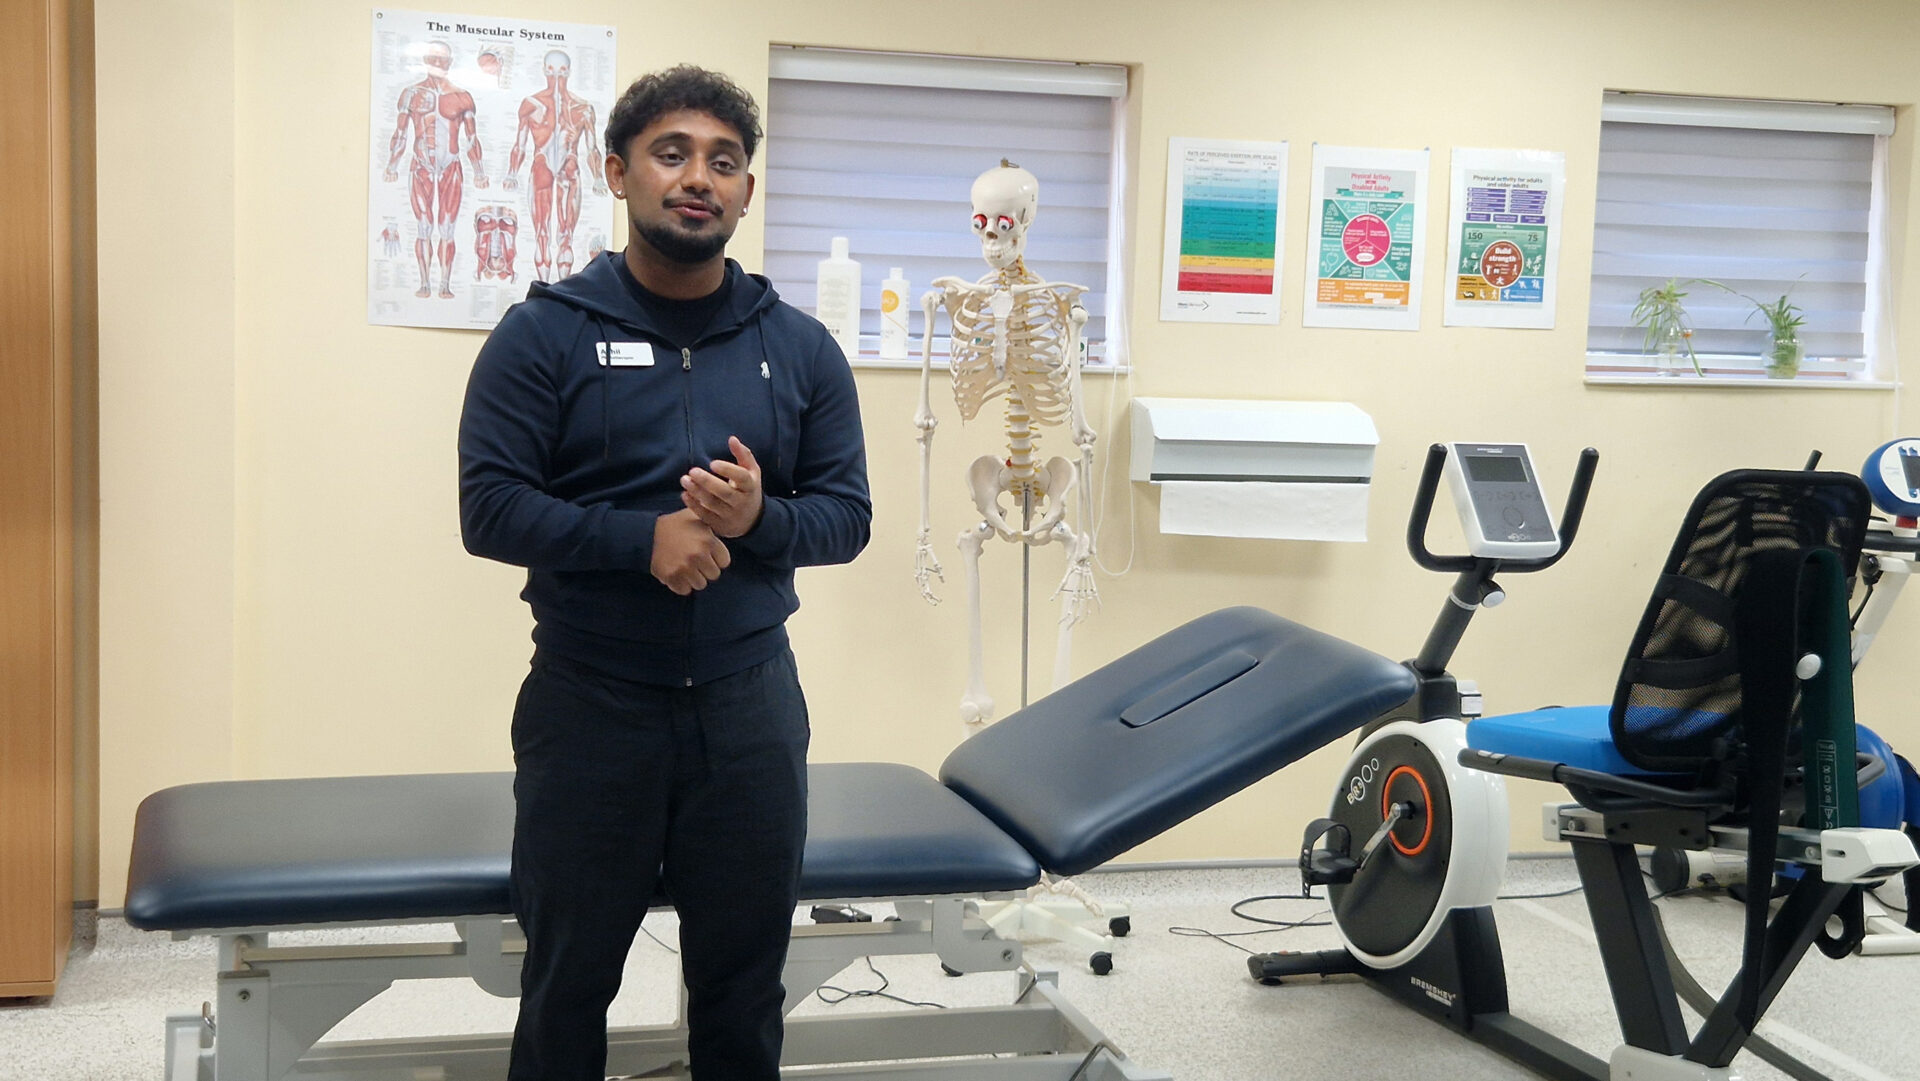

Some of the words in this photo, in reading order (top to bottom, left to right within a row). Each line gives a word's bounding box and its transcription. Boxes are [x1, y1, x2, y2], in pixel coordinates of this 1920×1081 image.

[426, 21, 451, 32] The
[455, 24, 515, 37] Muscular
[519, 28, 565, 41] System
[1473, 174, 1496, 182] Physical
[1467, 232, 1483, 240] 150
[1527, 234, 1539, 242] 75
[1494, 247, 1512, 255] Build
[1488, 255, 1517, 263] strength
